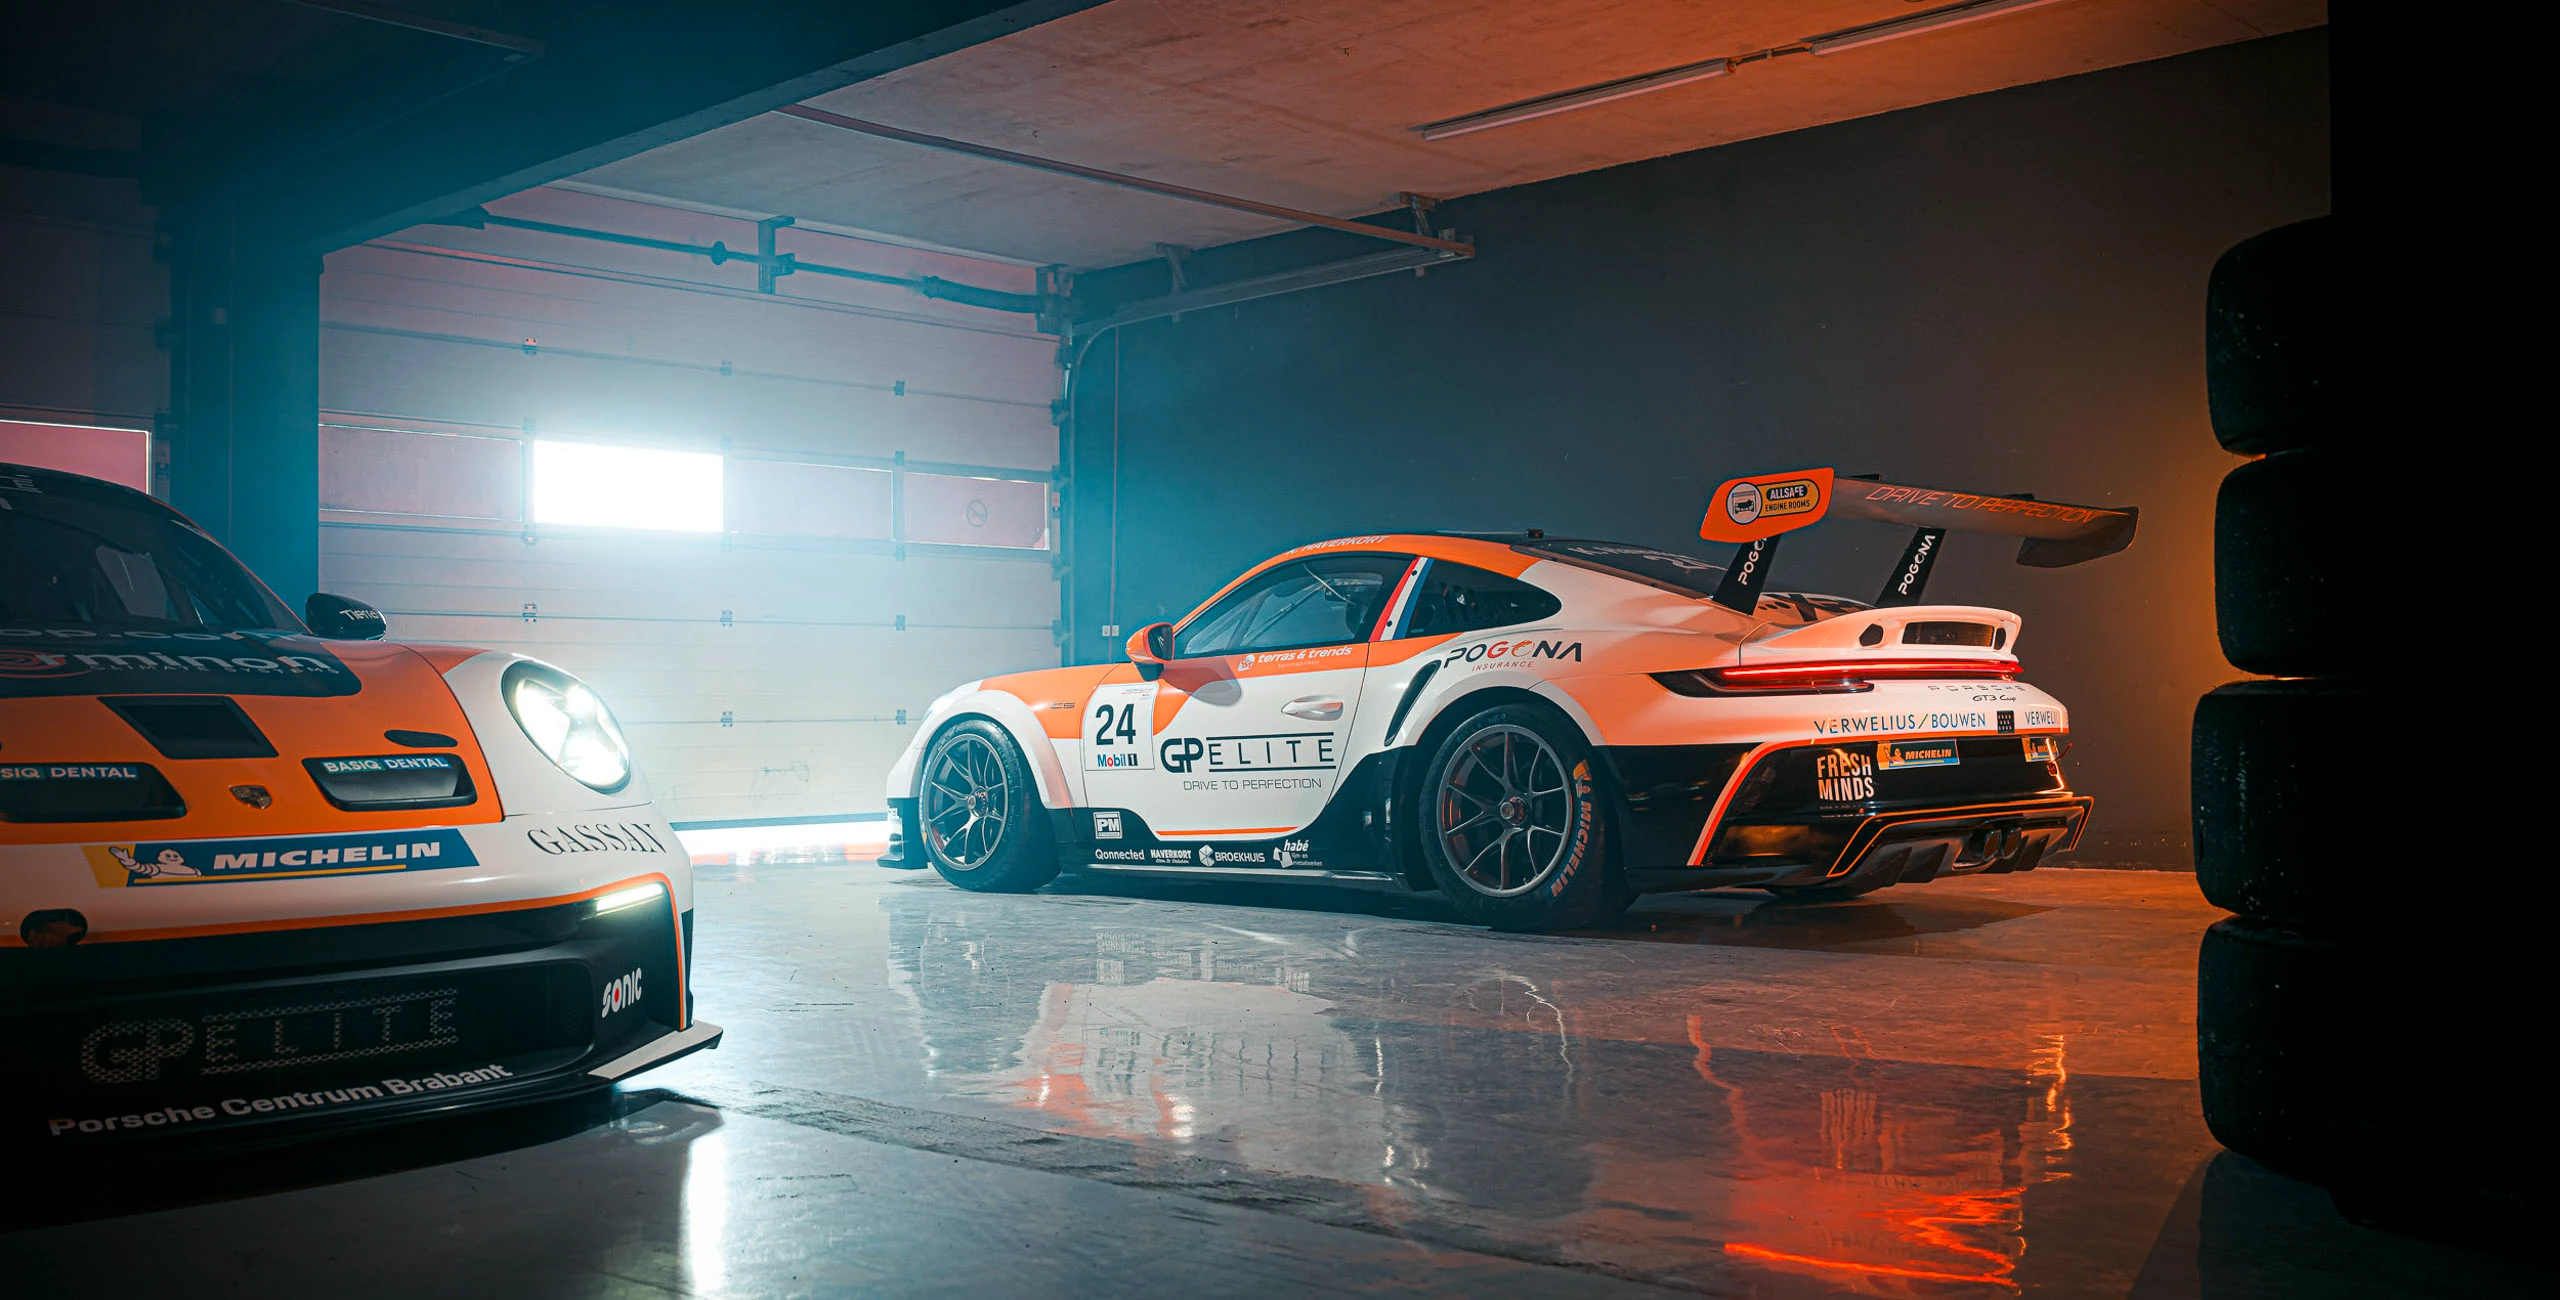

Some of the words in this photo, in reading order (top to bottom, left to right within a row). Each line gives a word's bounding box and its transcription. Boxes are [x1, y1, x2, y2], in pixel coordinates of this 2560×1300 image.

[1765, 502, 1787, 512] ENGINE
[1788, 500, 1811, 510] ROOMS
[1865, 486, 1946, 506] DRIVE
[1943, 493, 1980, 509] TO
[1973, 497, 2099, 524] PERFECTION
[1737, 537, 1767, 586] POGO
[1897, 534, 1936, 596] POGONA
[1257, 651, 1296, 663] terras
[1297, 650, 1307, 660] &
[1307, 646, 1353, 659] trends
[1443, 639, 1582, 669] POGONA
[1471, 660, 1535, 672] INSURANCE
[1095, 703, 1137, 746] 24
[1097, 753, 1127, 767] Mobil
[1905, 748, 1952, 761] MICHELIN
[51, 766, 137, 778] DENTAL
[323, 759, 382, 773] BASIQ
[385, 757, 449, 770] DENTAL
[1816, 753, 1873, 778] FRESH
[1183, 780, 1218, 791] DRIVE
[1221, 780, 1239, 790] TO
[1242, 778, 1322, 790] PERFECTION
[1818, 777, 1875, 801] MINDS
[1097, 818, 1120, 831] PM
[527, 822, 667, 856] GASSAN
[1284, 839, 1309, 852] habé
[213, 842, 441, 870] MICHELIN
[1095, 848, 1145, 860] Qonnected
[1150, 848, 1192, 859] HAVERKORT
[1550, 801, 1592, 897] MICHELIN
[1214, 852, 1266, 863] BROEKHUIS
[50, 1105, 216, 1136] Porsche
[220, 1083, 383, 1117] Centrum
[382, 1064, 514, 1097] Brabant
